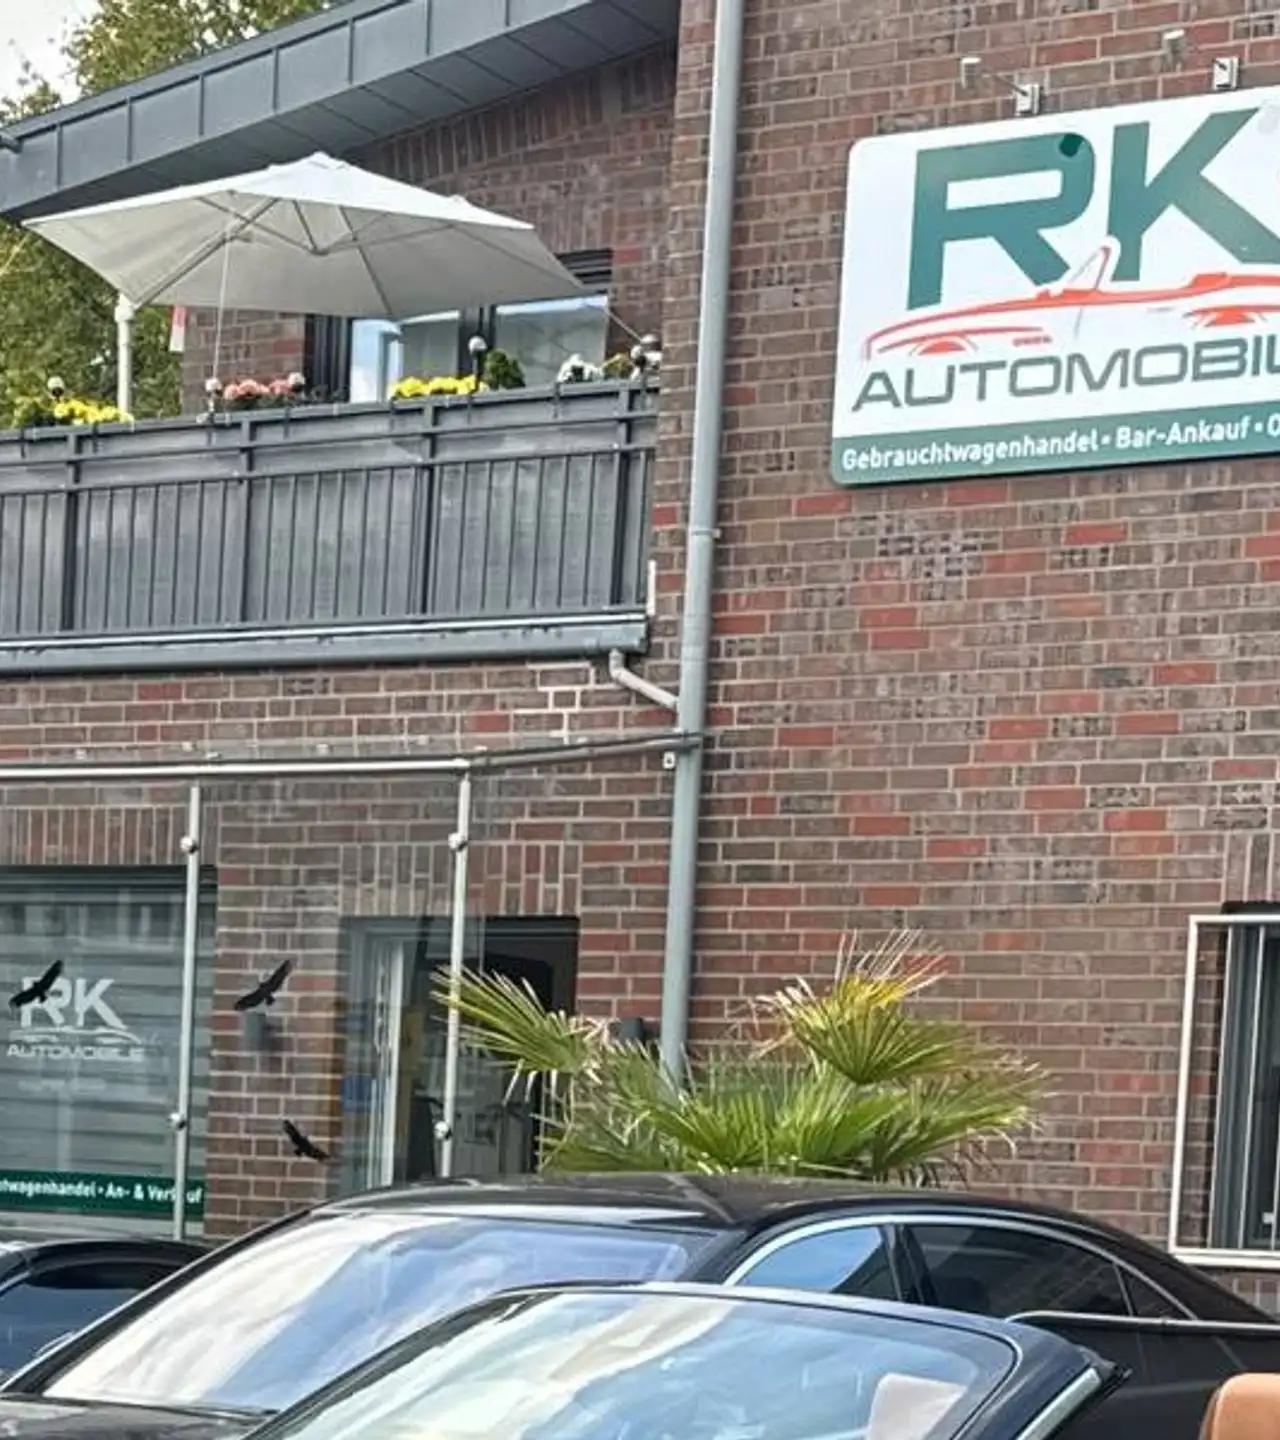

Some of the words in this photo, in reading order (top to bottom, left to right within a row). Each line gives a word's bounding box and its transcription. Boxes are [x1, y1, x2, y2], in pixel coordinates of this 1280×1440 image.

[842, 428, 1098, 470] Gebrauchtwagenhandel
[1115, 415, 1252, 449] Bar-Ankauf
[147, 1184, 204, 1204] Veruf
